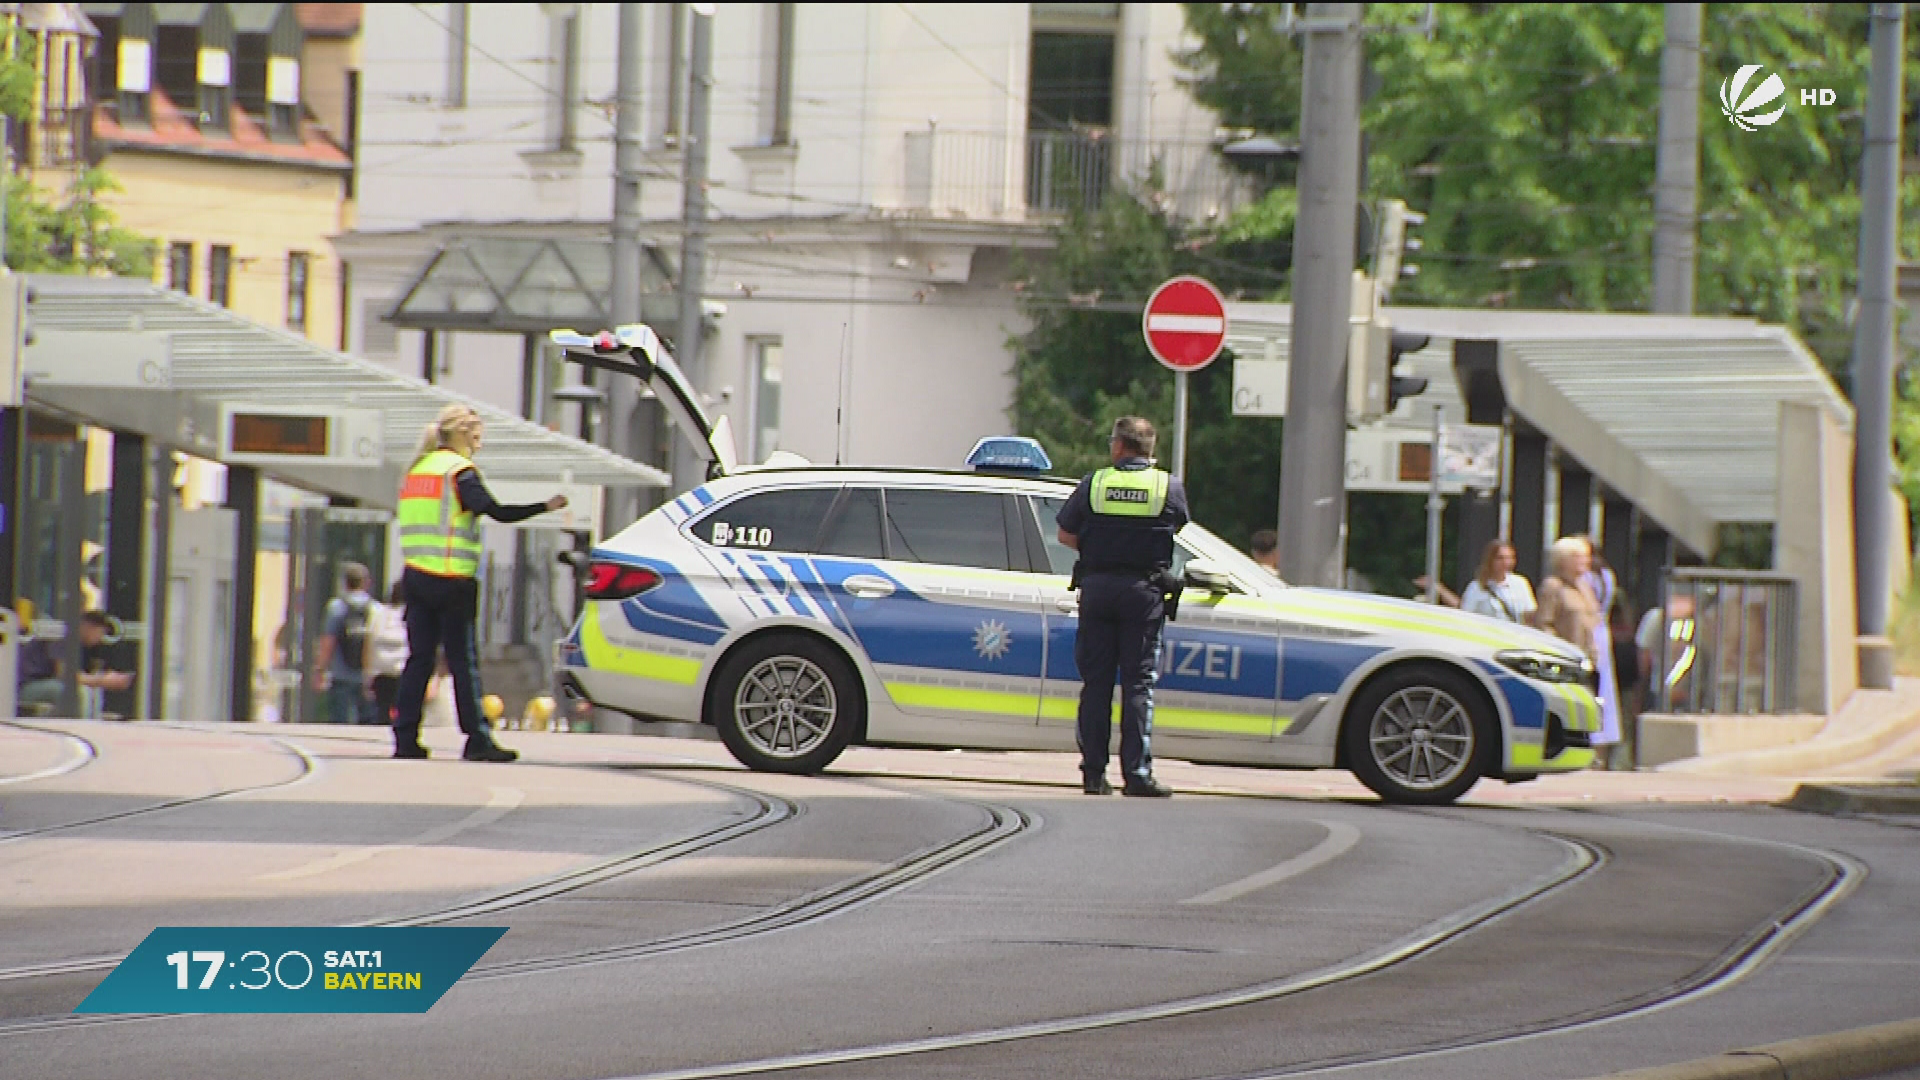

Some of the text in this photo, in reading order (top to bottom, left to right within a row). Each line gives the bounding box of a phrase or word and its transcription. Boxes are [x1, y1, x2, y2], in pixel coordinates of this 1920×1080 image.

[1107, 488, 1147, 501] POLIZEI
[735, 526, 773, 546] 110
[1160, 640, 1241, 679] IZEI
